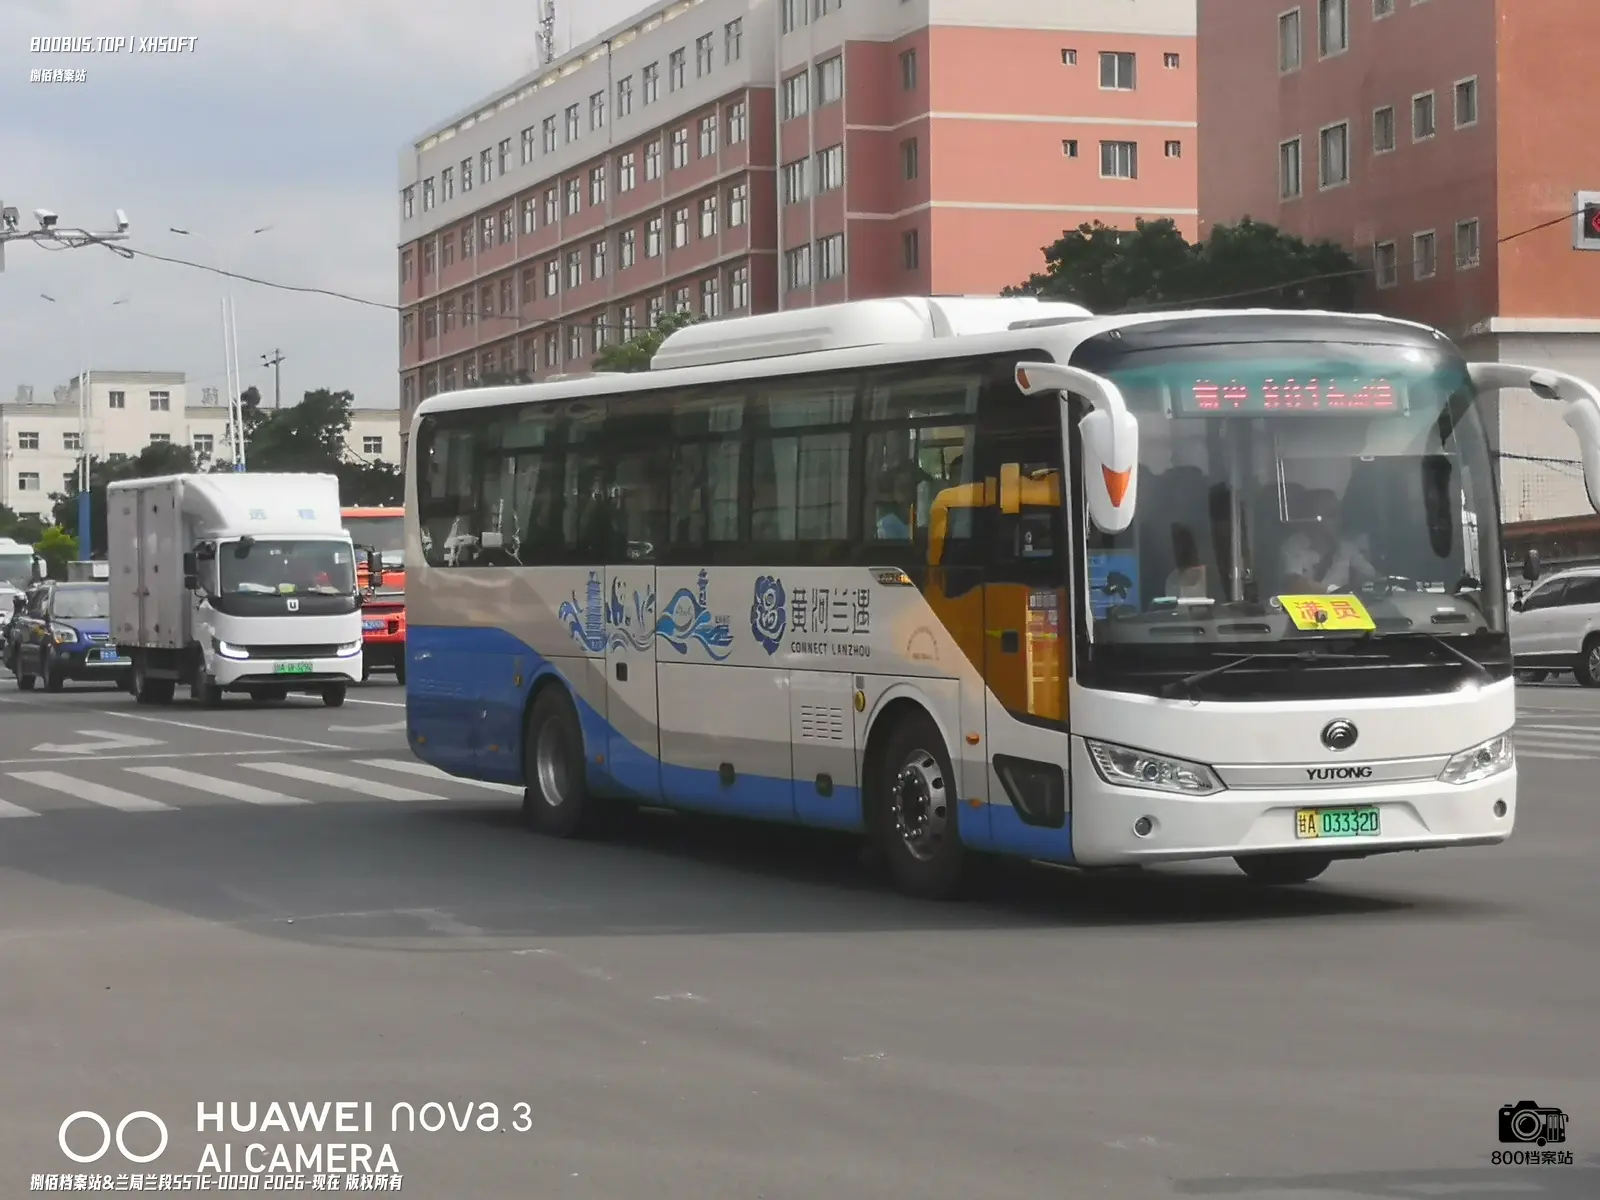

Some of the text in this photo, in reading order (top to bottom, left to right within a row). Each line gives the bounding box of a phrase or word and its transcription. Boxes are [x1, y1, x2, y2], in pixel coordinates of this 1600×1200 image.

[791, 588, 870, 634] 黄河兰遇
[791, 642, 870, 657] CONNECT LANZHOU
[1306, 766, 1373, 780] YUTONG
